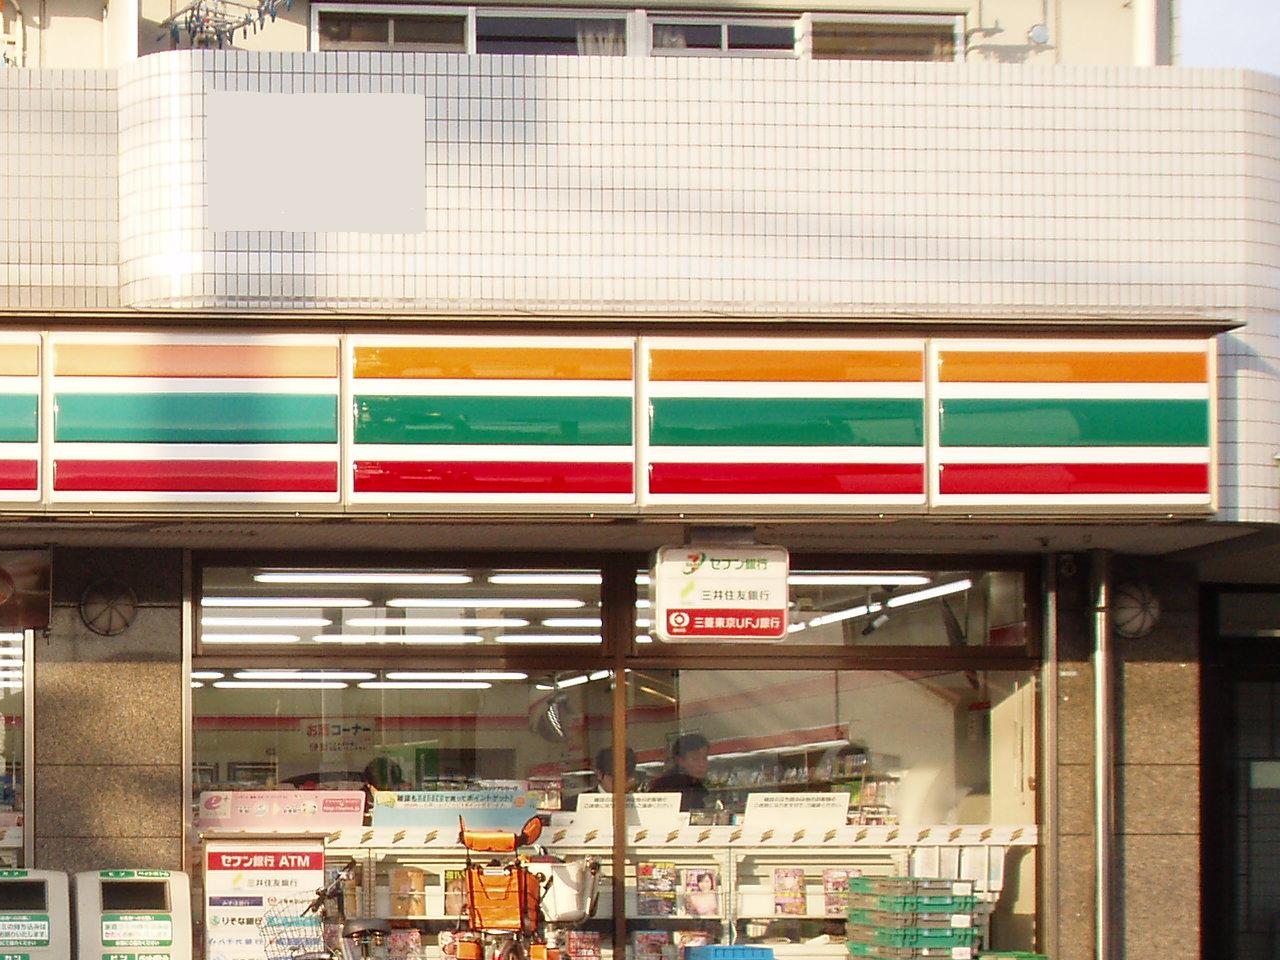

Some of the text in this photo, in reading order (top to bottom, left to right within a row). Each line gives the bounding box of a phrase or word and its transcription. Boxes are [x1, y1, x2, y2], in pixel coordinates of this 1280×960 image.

[710, 558, 769, 570] セブン銀行
[701, 589, 770, 601] 三井住友銀行
[694, 617, 781, 629] 三菱東京UFJ銀行
[221, 855, 310, 867] セブン銀行 ATM
[247, 879, 298, 888] 三井住友銀行
